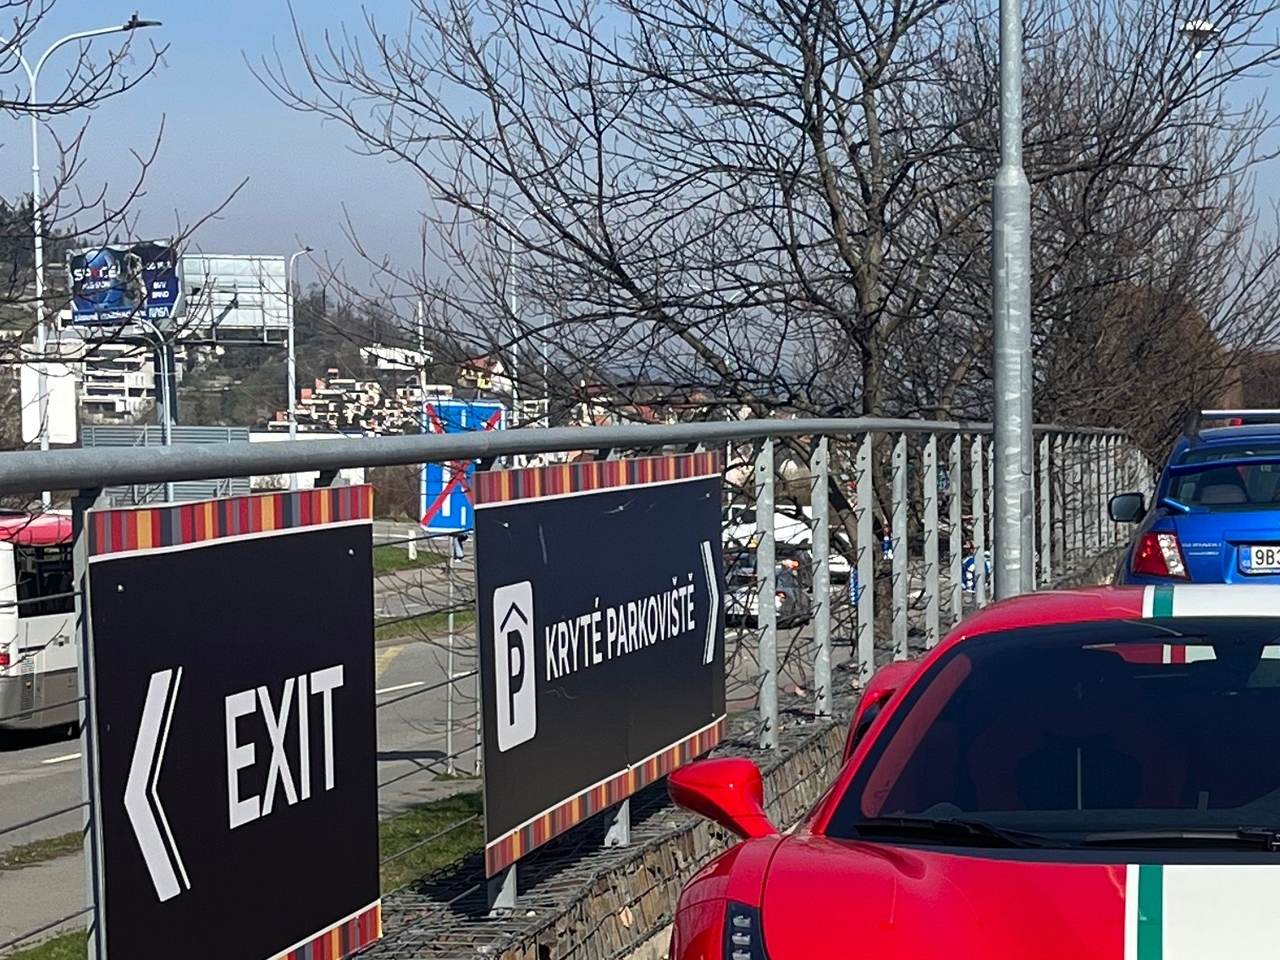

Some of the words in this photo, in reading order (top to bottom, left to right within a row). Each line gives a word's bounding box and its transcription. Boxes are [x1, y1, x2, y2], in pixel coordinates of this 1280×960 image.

[545, 597, 603, 682] KRYTÉ
[606, 572, 696, 660] PARKOVIŠTĚ
[225, 664, 344, 830] EXIT
